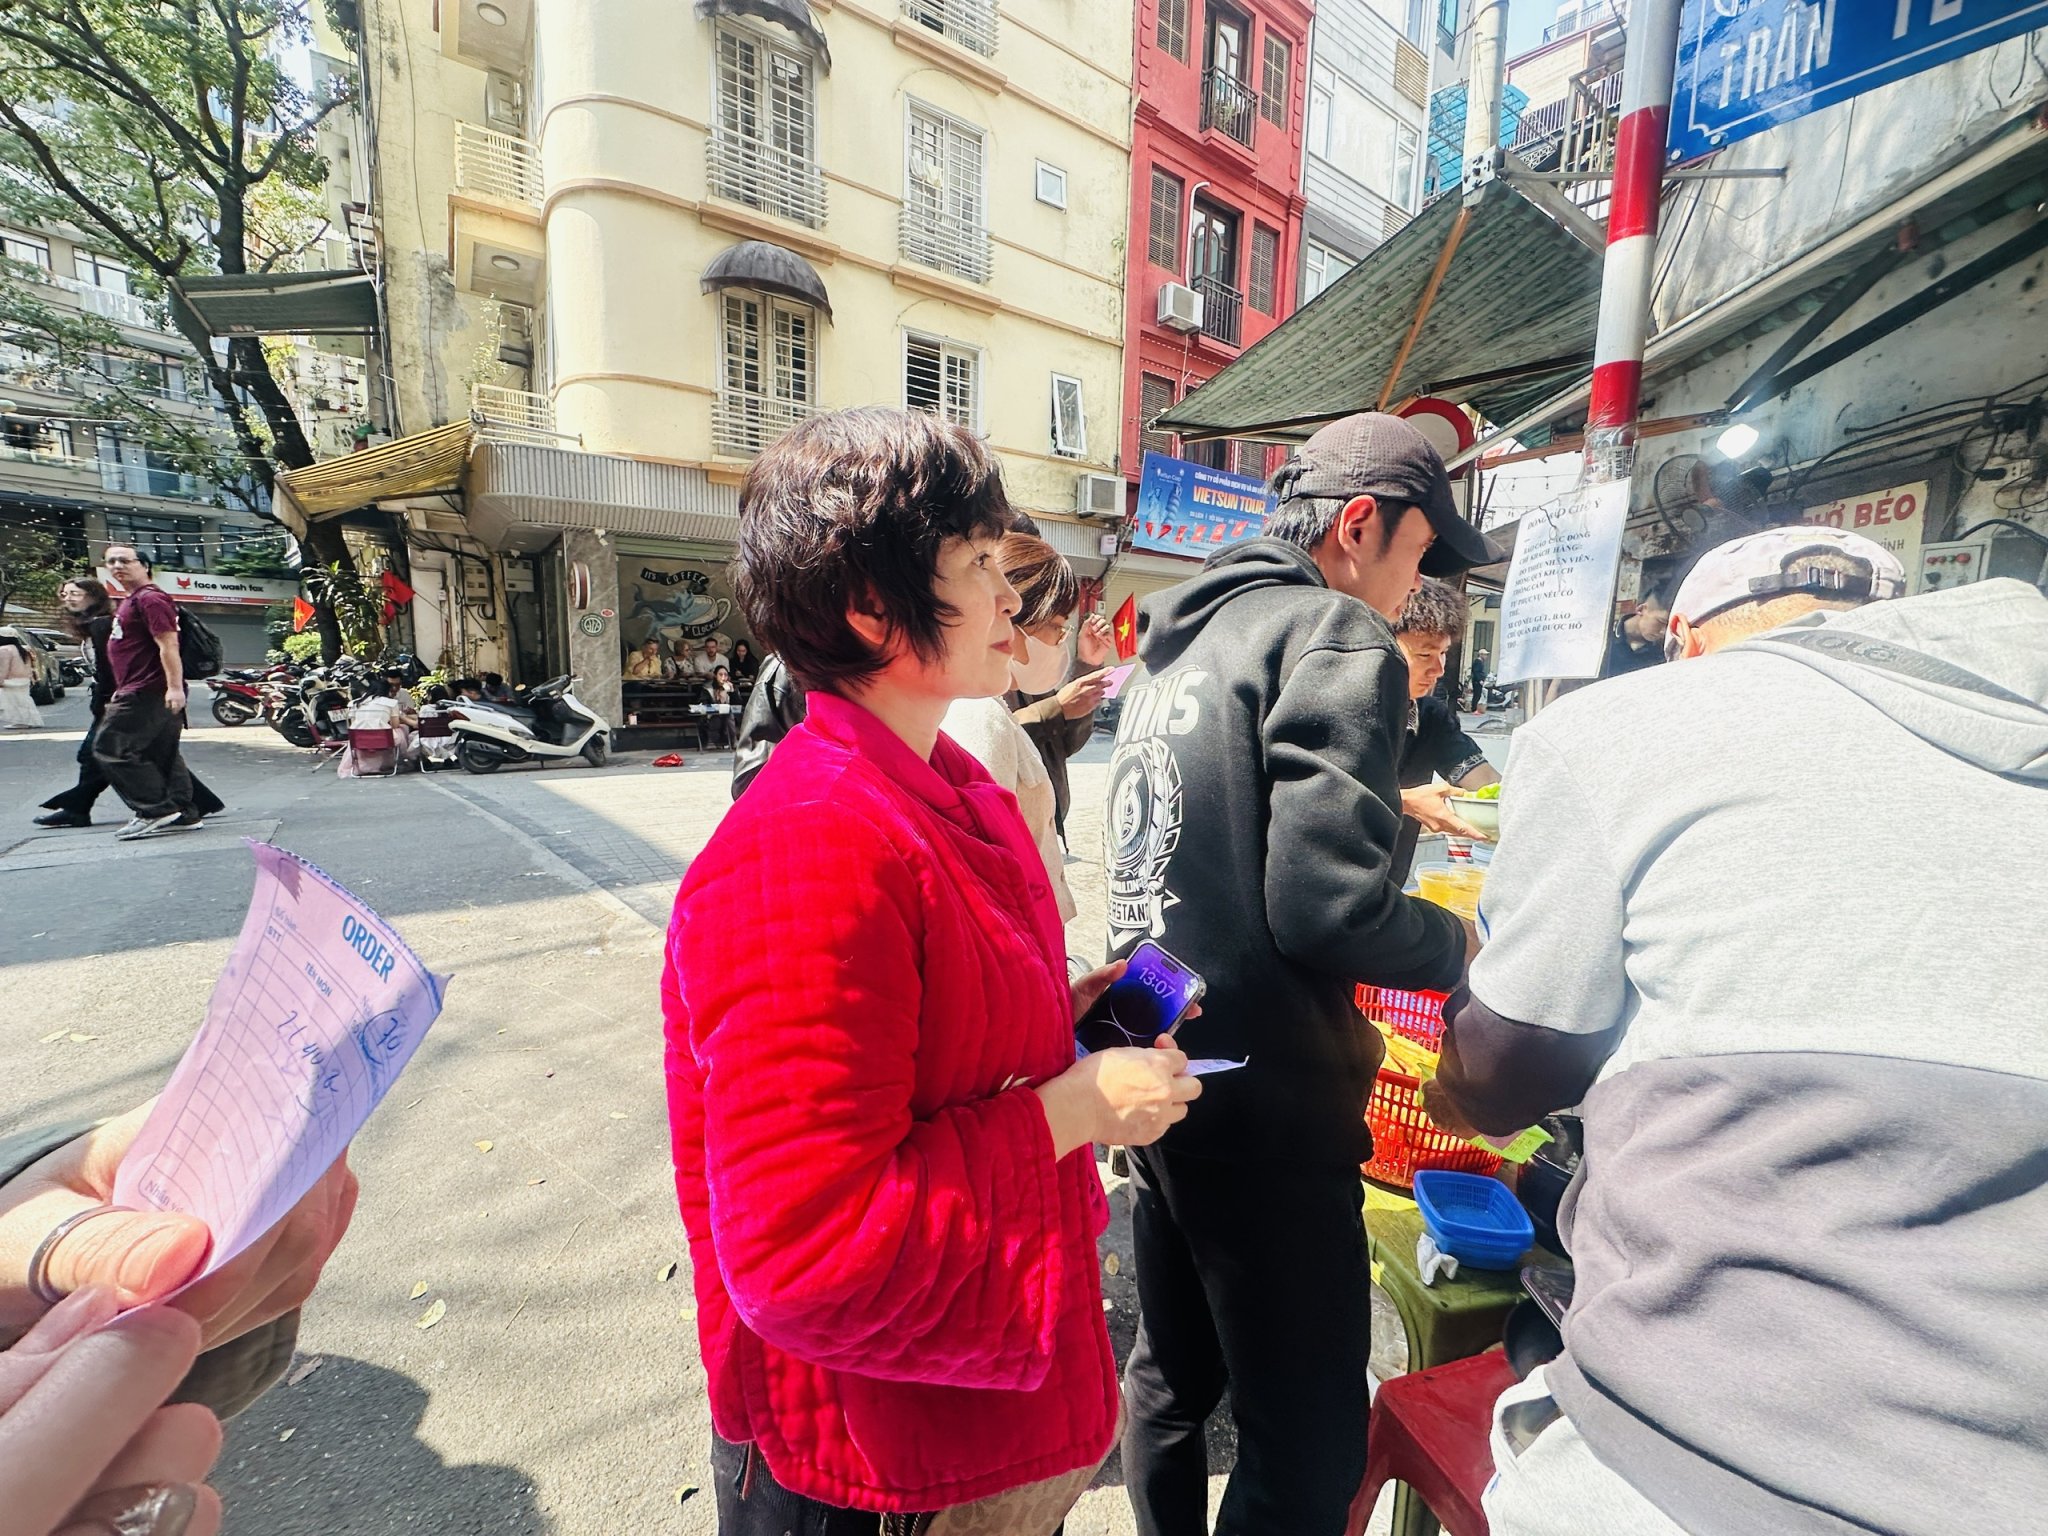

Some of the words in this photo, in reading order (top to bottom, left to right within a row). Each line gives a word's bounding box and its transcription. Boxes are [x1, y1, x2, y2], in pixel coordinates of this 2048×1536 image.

[1193, 486, 1238, 510] VIETSUN
[1238, 495, 1265, 515] TOUR
[1854, 490, 1916, 529] BÉO
[194, 580, 217, 590] face
[220, 583, 247, 592] wash
[248, 584, 264, 592] fox
[666, 571, 706, 585] COFFEE
[267, 925, 282, 942] STT
[341, 914, 396, 984] ORDER
[1139, 966, 1177, 999] 13:07
